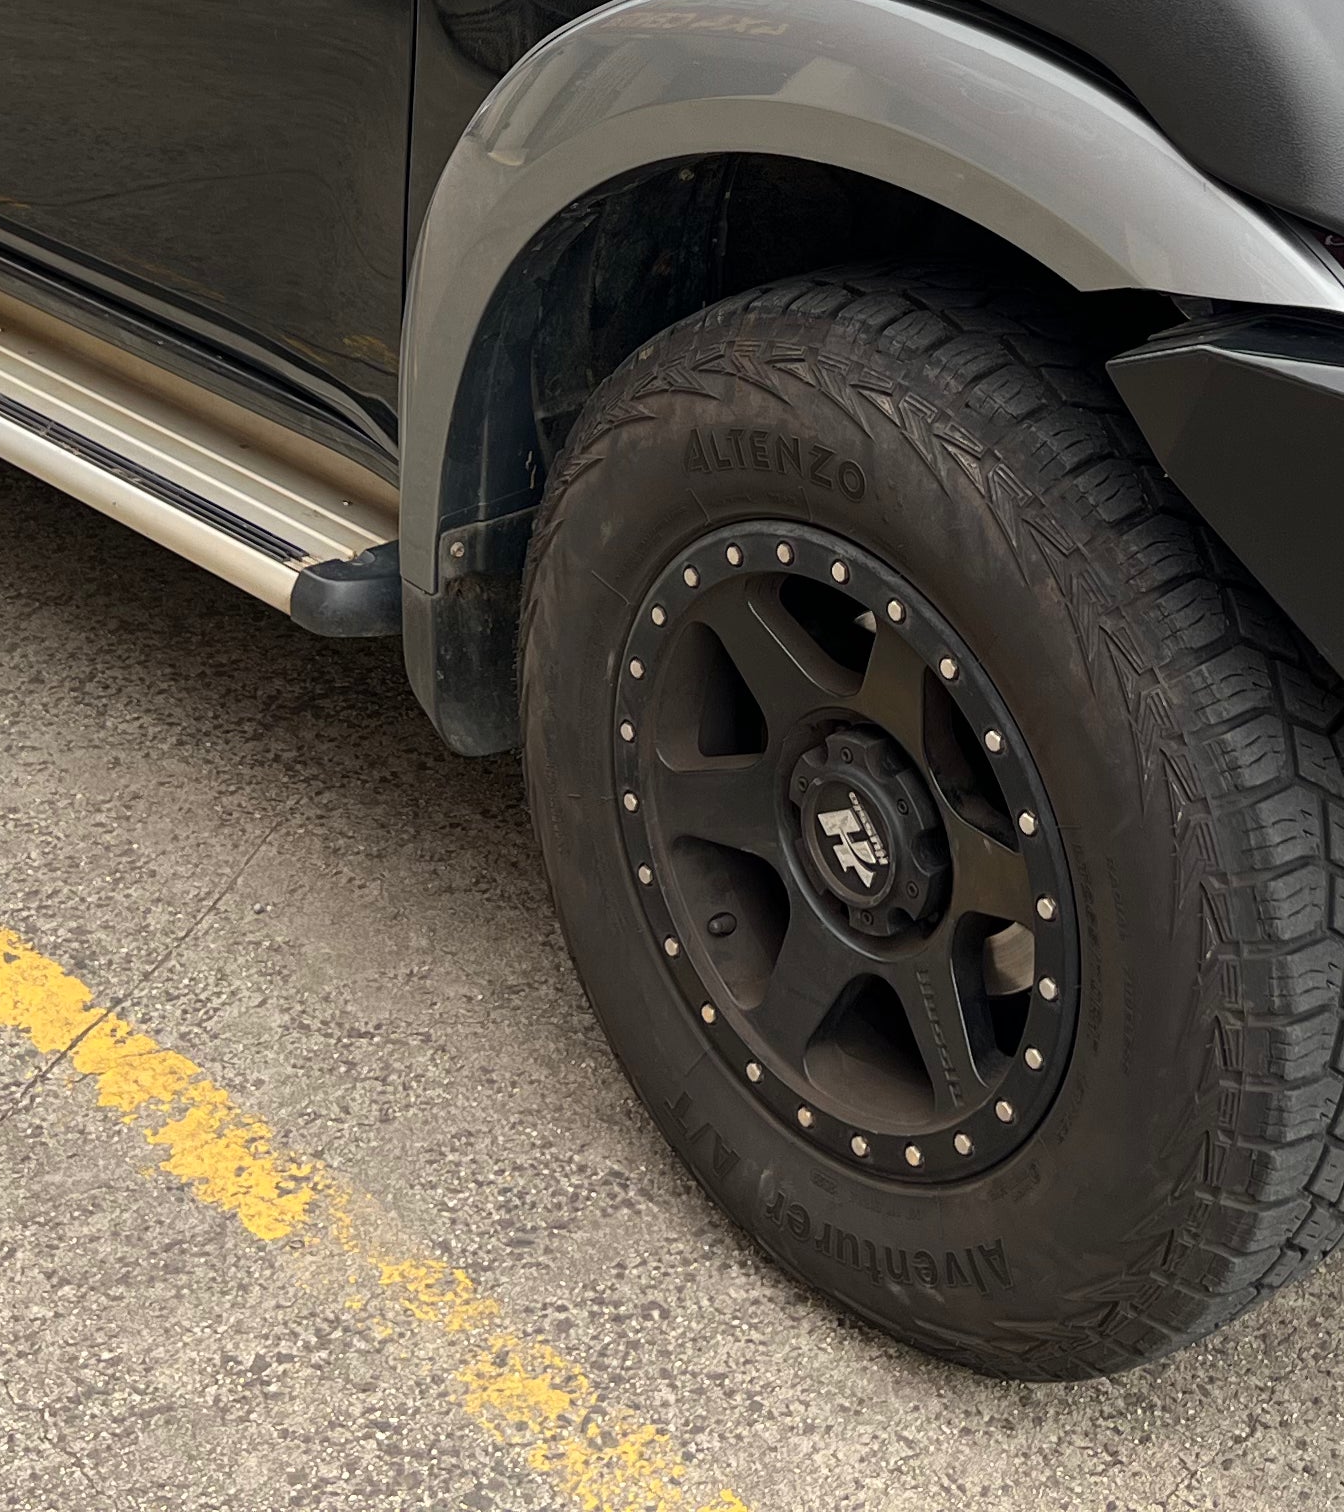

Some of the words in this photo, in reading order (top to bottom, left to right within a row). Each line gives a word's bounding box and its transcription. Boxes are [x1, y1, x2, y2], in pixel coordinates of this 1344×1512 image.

[682, 427, 868, 503] ALTENZO
[663, 1089, 741, 1179] A/T
[758, 1187, 1015, 1296] Alventurer
